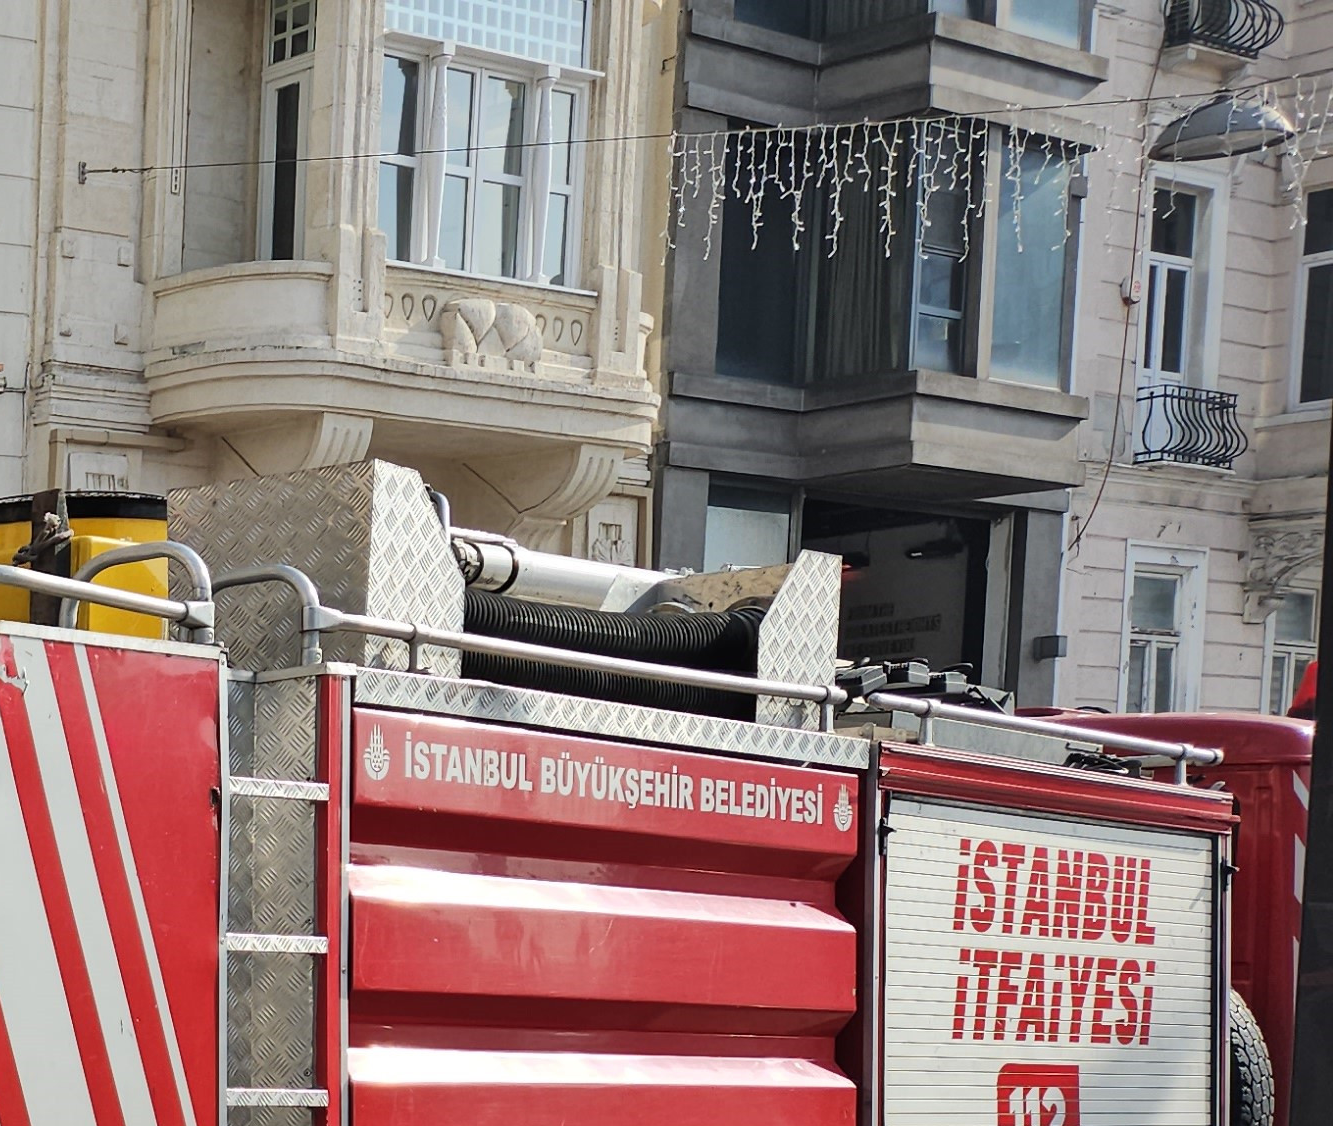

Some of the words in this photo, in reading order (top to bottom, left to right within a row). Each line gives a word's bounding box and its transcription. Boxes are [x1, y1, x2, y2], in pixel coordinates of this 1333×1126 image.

[405, 732, 533, 792] İSTANBUL
[541, 752, 694, 810] BÜYÜKŞEHİR
[700, 777, 824, 825] BELEDİYESİ
[953, 838, 1157, 945] İSTANBUL
[951, 948, 1157, 1046] İTFAİYESİ
